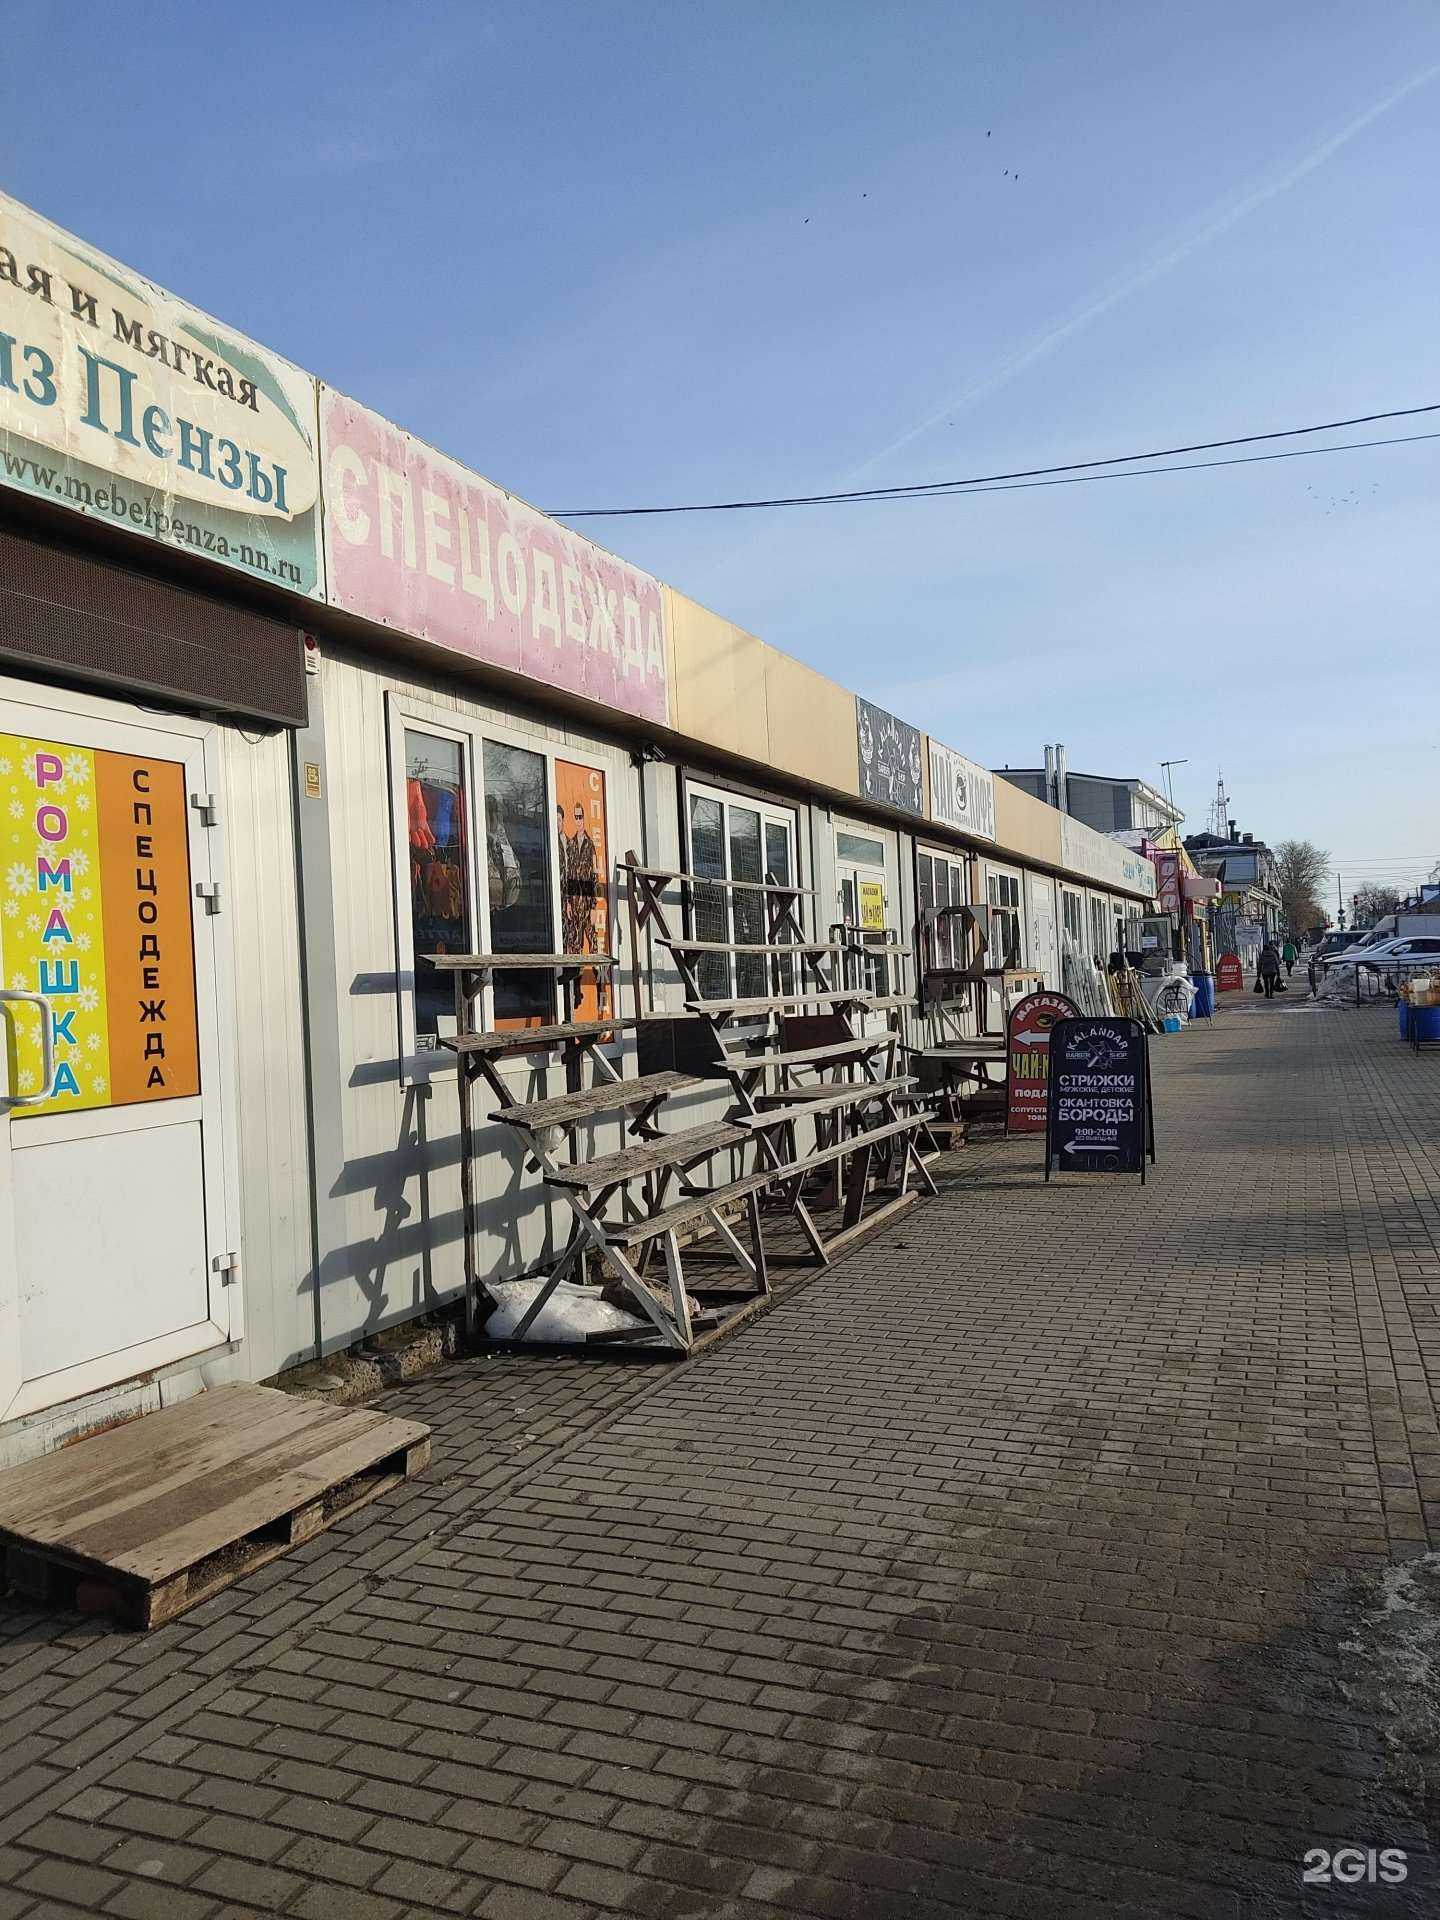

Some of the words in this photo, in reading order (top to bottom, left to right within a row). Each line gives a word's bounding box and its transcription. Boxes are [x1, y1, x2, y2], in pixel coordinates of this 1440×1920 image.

[67, 284, 100, 328] и
[112, 307, 260, 412] мягкая
[77, 344, 290, 514] Пензы
[329, 444, 664, 688] СПЕЦОДЕЖДА
[34, 752, 81, 1099] РОМАШКА
[133, 768, 167, 1089] СПЕЦОДЕЖДА
[1017, 998, 1075, 1021] МАГАЗИН
[1067, 1028, 1129, 1051] KALANDAR
[1058, 1108, 1134, 1124] БОРОДЫ
[1059, 1074, 1135, 1086] СТРИЖКИ
[1059, 1098, 1134, 1108] ОКАНТОВКА
